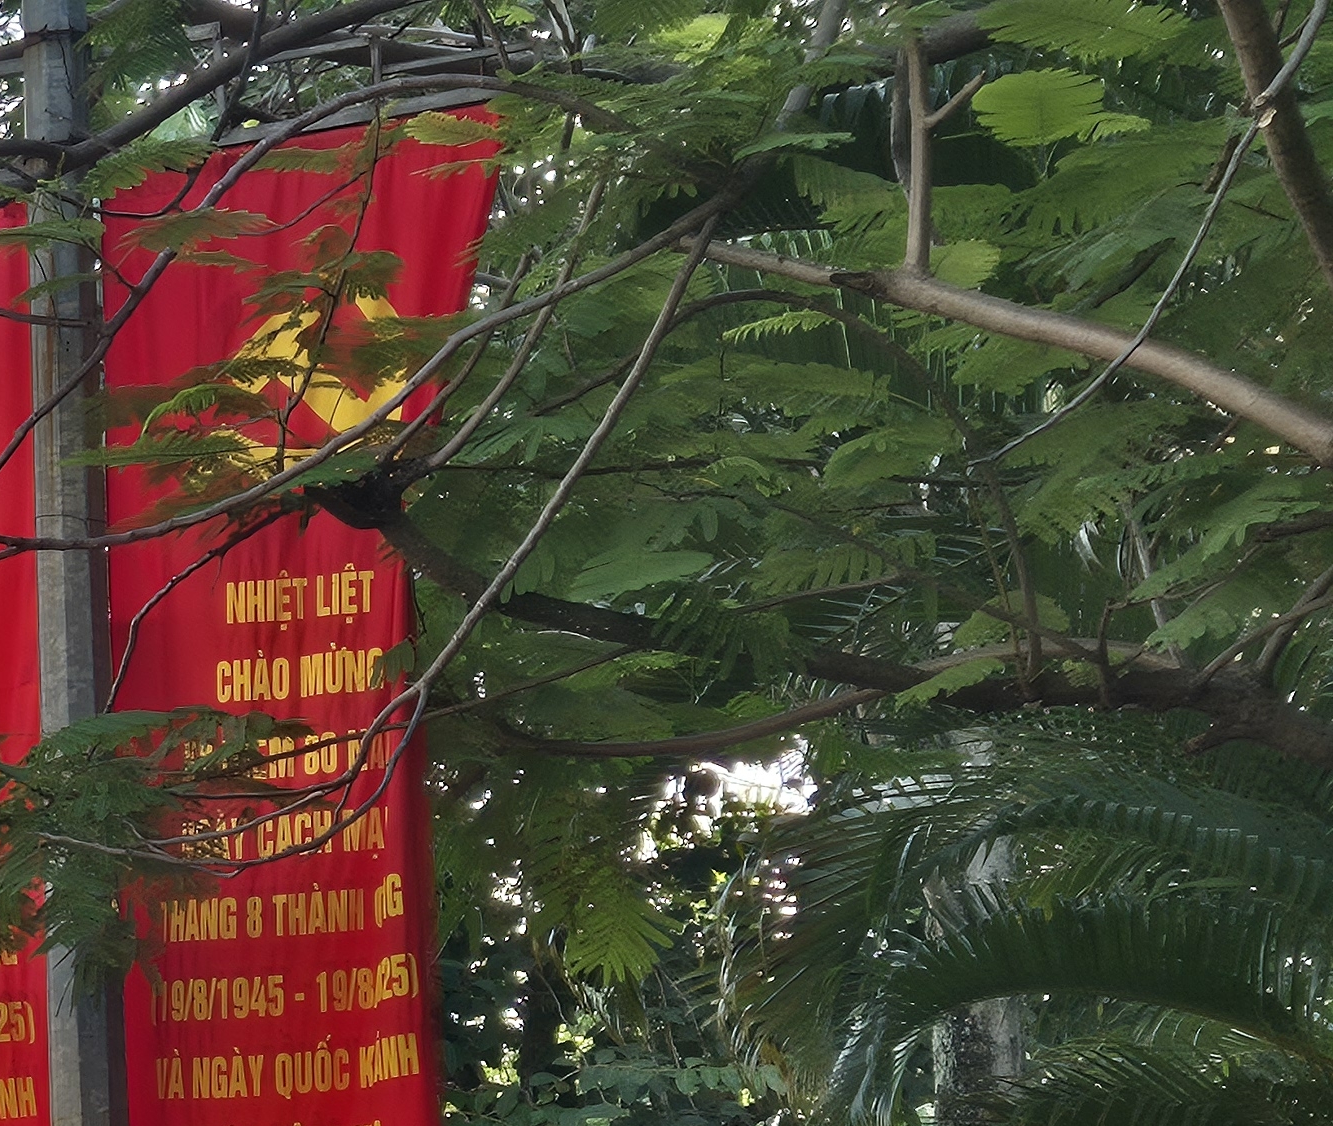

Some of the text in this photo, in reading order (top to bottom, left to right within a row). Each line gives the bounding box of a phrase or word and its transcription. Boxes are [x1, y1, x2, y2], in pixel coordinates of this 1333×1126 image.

[226, 562, 374, 631] NHIỆT LIỆT
[216, 649, 290, 703] CHÀO
[246, 897, 263, 938] 8
[272, 882, 364, 936] THÀNH
[294, 992, 305, 1001] -
[155, 1047, 184, 1099] VÀ
[192, 1046, 264, 1099] NGÀY
[275, 1033, 350, 1100] QUỐC
